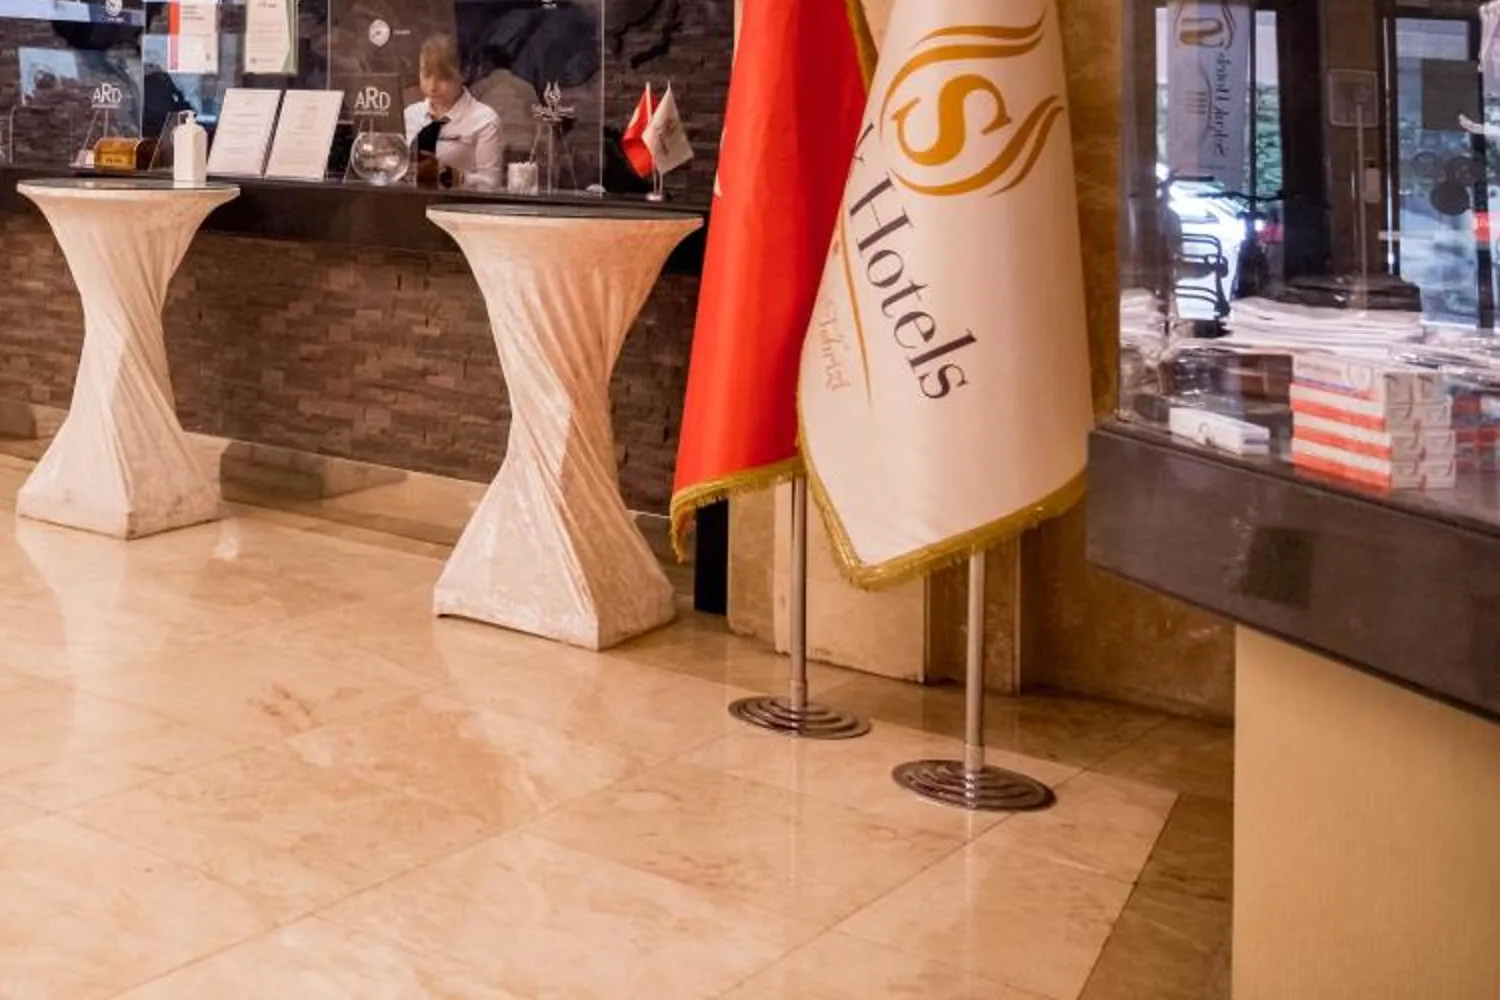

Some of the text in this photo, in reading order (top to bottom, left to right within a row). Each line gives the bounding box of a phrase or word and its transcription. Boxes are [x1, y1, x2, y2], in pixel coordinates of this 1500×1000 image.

[92, 83, 122, 103] ARD
[353, 87, 391, 109] ARD
[848, 171, 978, 400] Hotels
